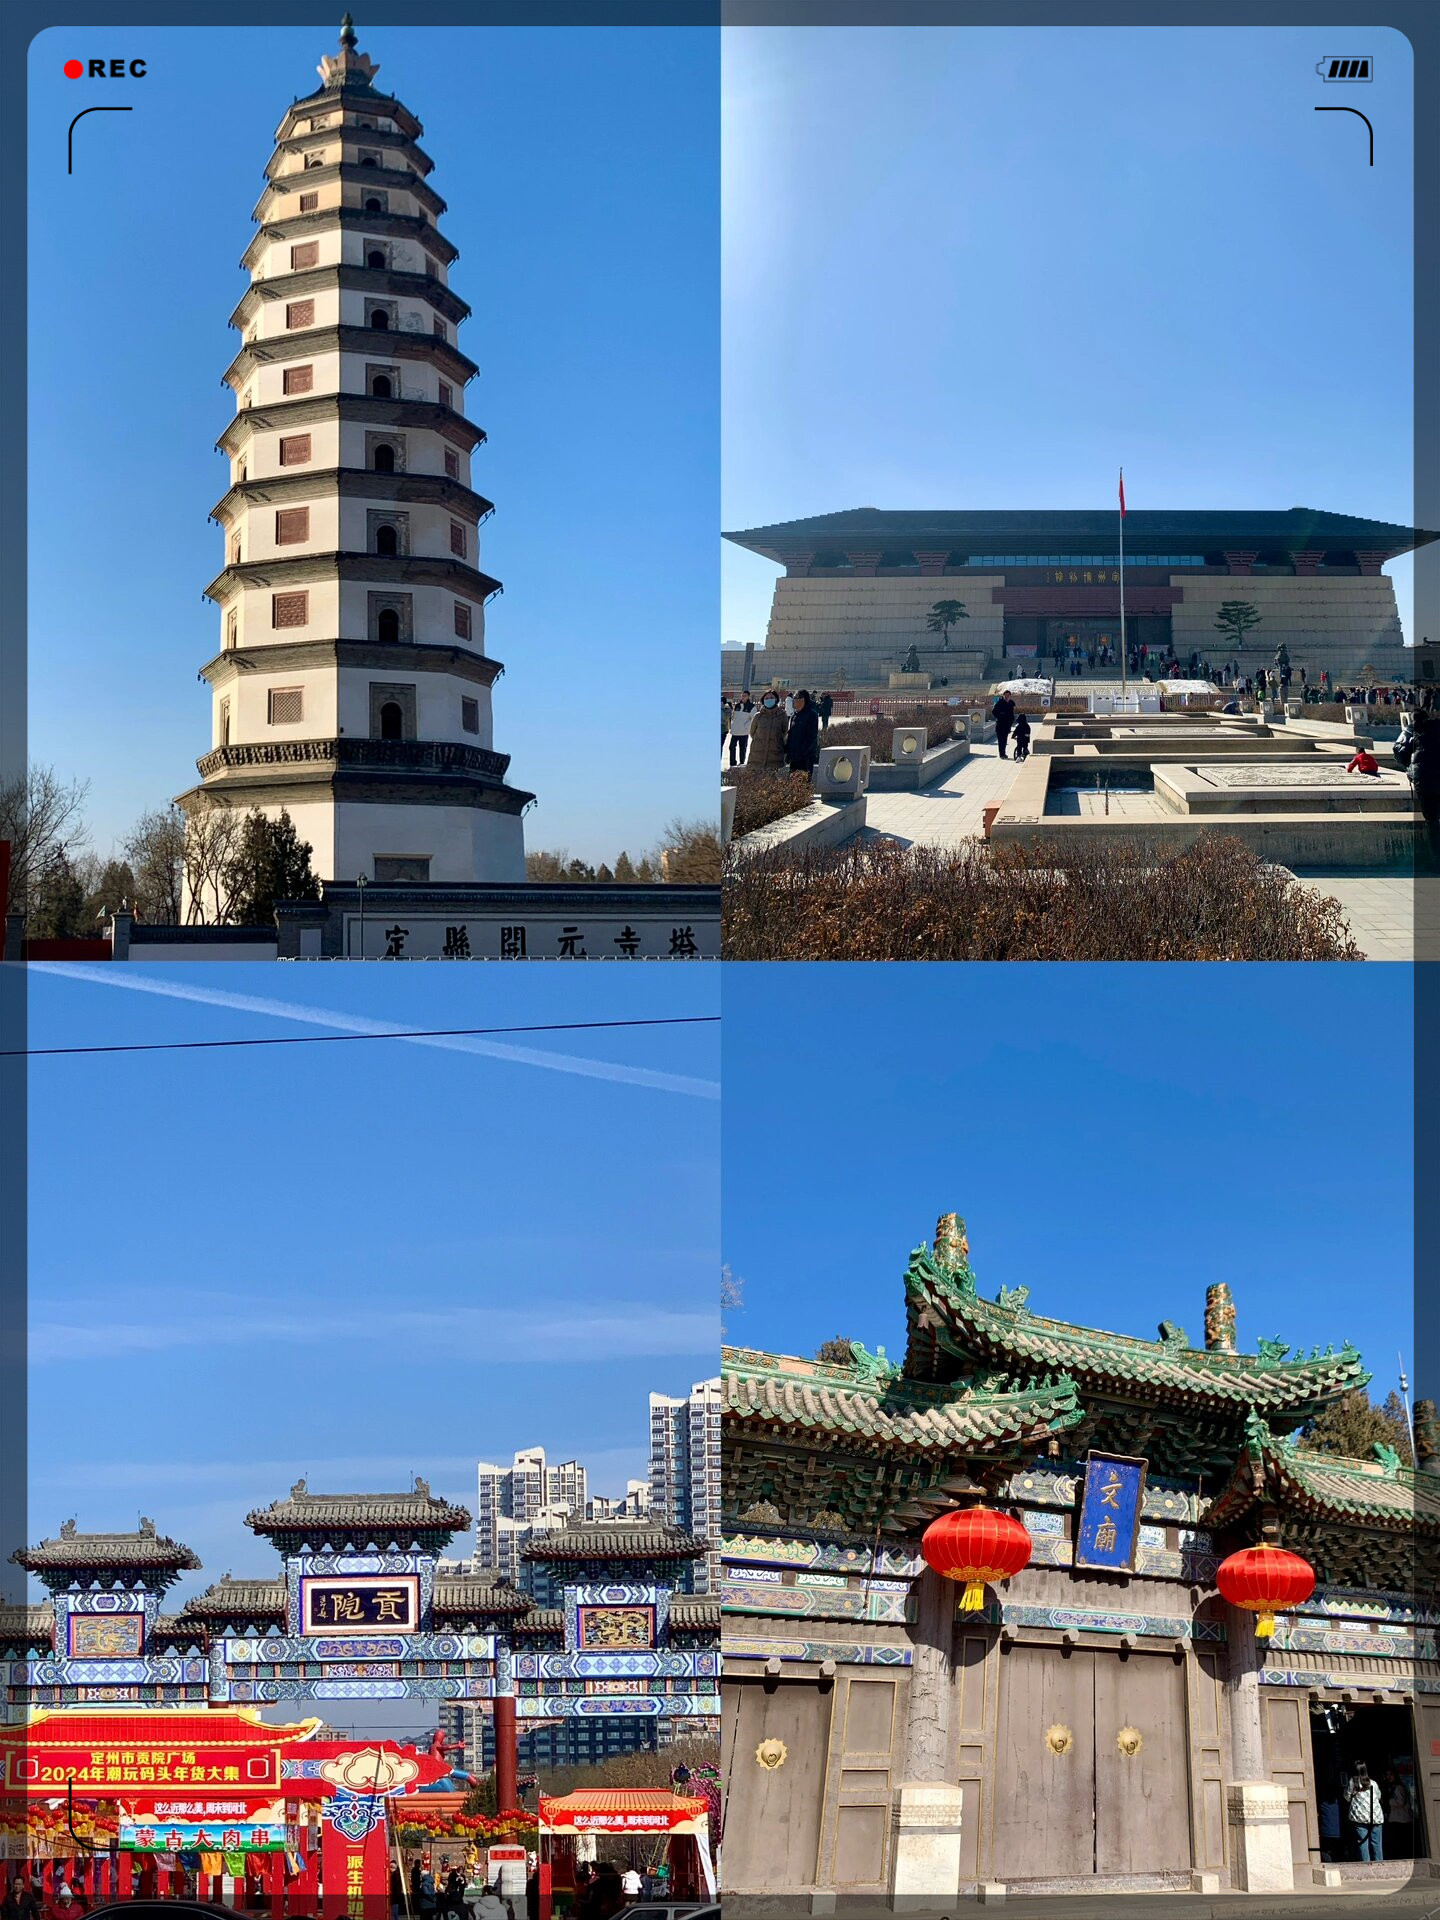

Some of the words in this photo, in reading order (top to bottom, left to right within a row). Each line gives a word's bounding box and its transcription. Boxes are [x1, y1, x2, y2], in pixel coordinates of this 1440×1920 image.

[90, 1750, 196, 1765] 定州市贡院广场
[41, 1766, 240, 1782] 2024年潮玩码头年货大集
[134, 1828, 271, 1848] 蒙古大肉串
[346, 1845, 364, 1919] 一派生机迎
